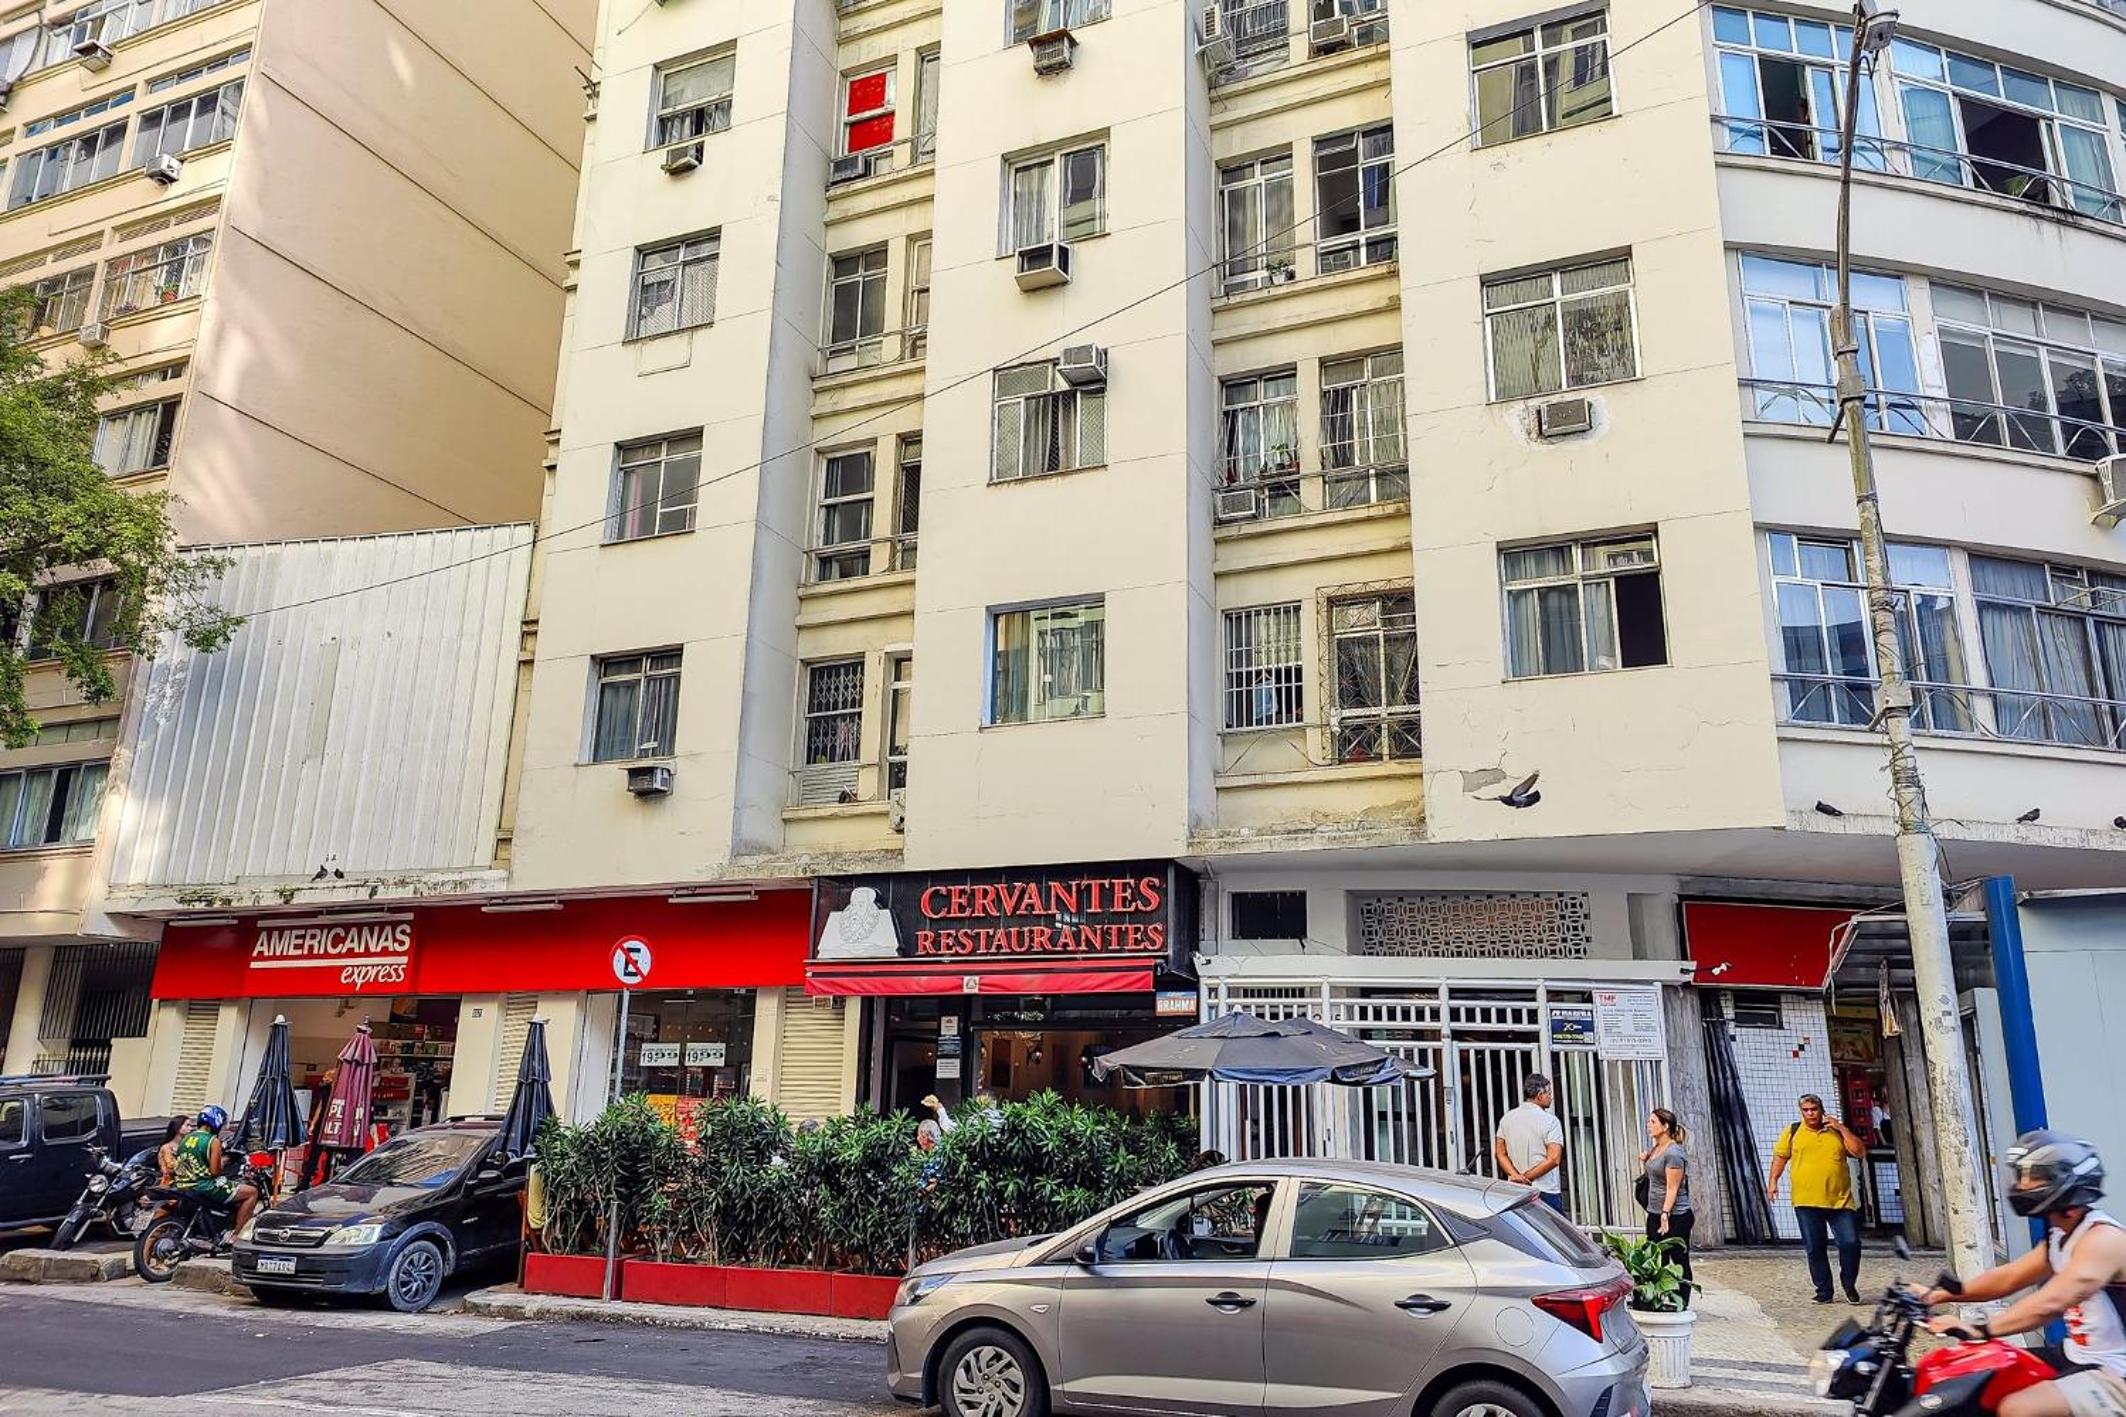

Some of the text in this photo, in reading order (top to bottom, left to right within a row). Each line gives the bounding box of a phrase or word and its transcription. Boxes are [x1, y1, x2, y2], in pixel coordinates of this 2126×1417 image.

[919, 876, 1162, 919] CERVANTES
[251, 923, 412, 957] AMERICANAS
[915, 921, 1164, 955] RESTAURANTES
[340, 964, 407, 992] express
[1157, 999, 1196, 1013] BRAHMA
